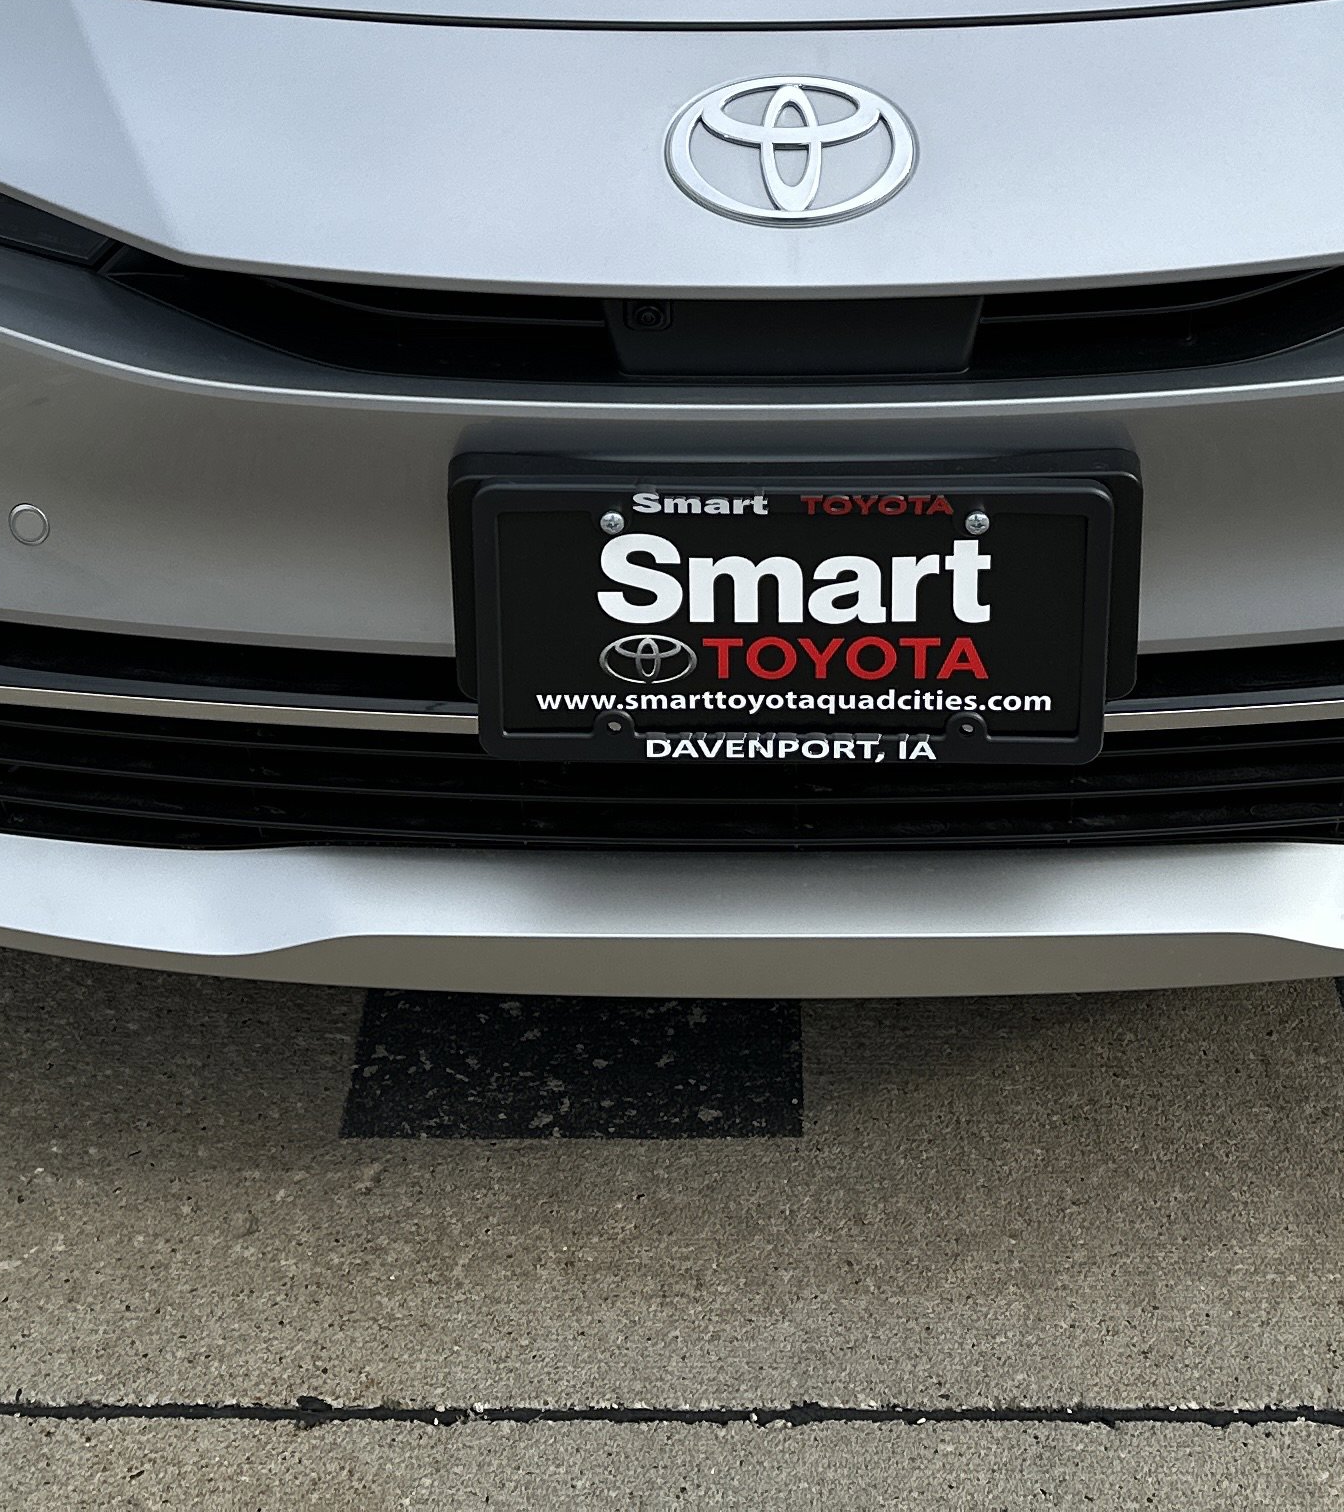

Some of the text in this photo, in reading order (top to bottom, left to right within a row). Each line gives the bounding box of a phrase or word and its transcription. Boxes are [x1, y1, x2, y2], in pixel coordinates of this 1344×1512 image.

[632, 492, 954, 516] Smart TOYOTA
[597, 533, 992, 625] Smart
[702, 637, 989, 680] TOYOTA
[536, 689, 1053, 715] www.smarttoyotaquadcities.com
[645, 738, 937, 763] DAVENPORT, IA
